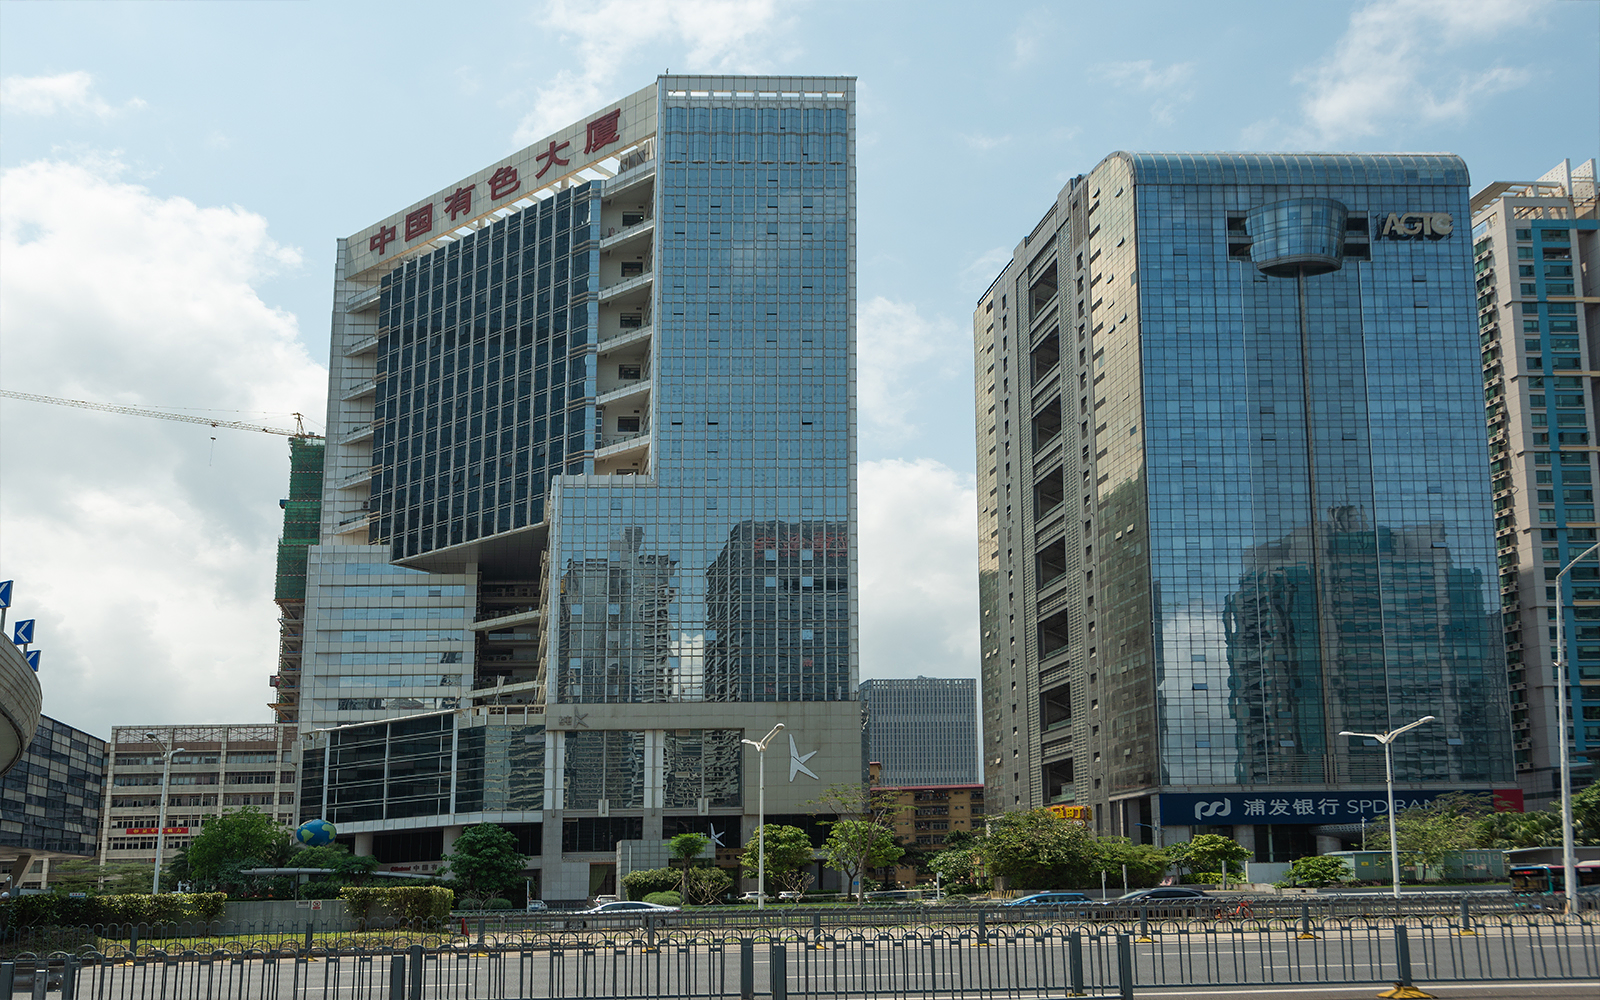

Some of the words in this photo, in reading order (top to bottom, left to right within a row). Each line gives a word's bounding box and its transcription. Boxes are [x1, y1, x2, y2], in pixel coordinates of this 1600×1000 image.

[369, 108, 621, 255] 中国有色大厦
[1243, 798, 1340, 816] 浦发银行
[1346, 799, 1389, 814] SPD
[1394, 798, 1452, 814] BAN
